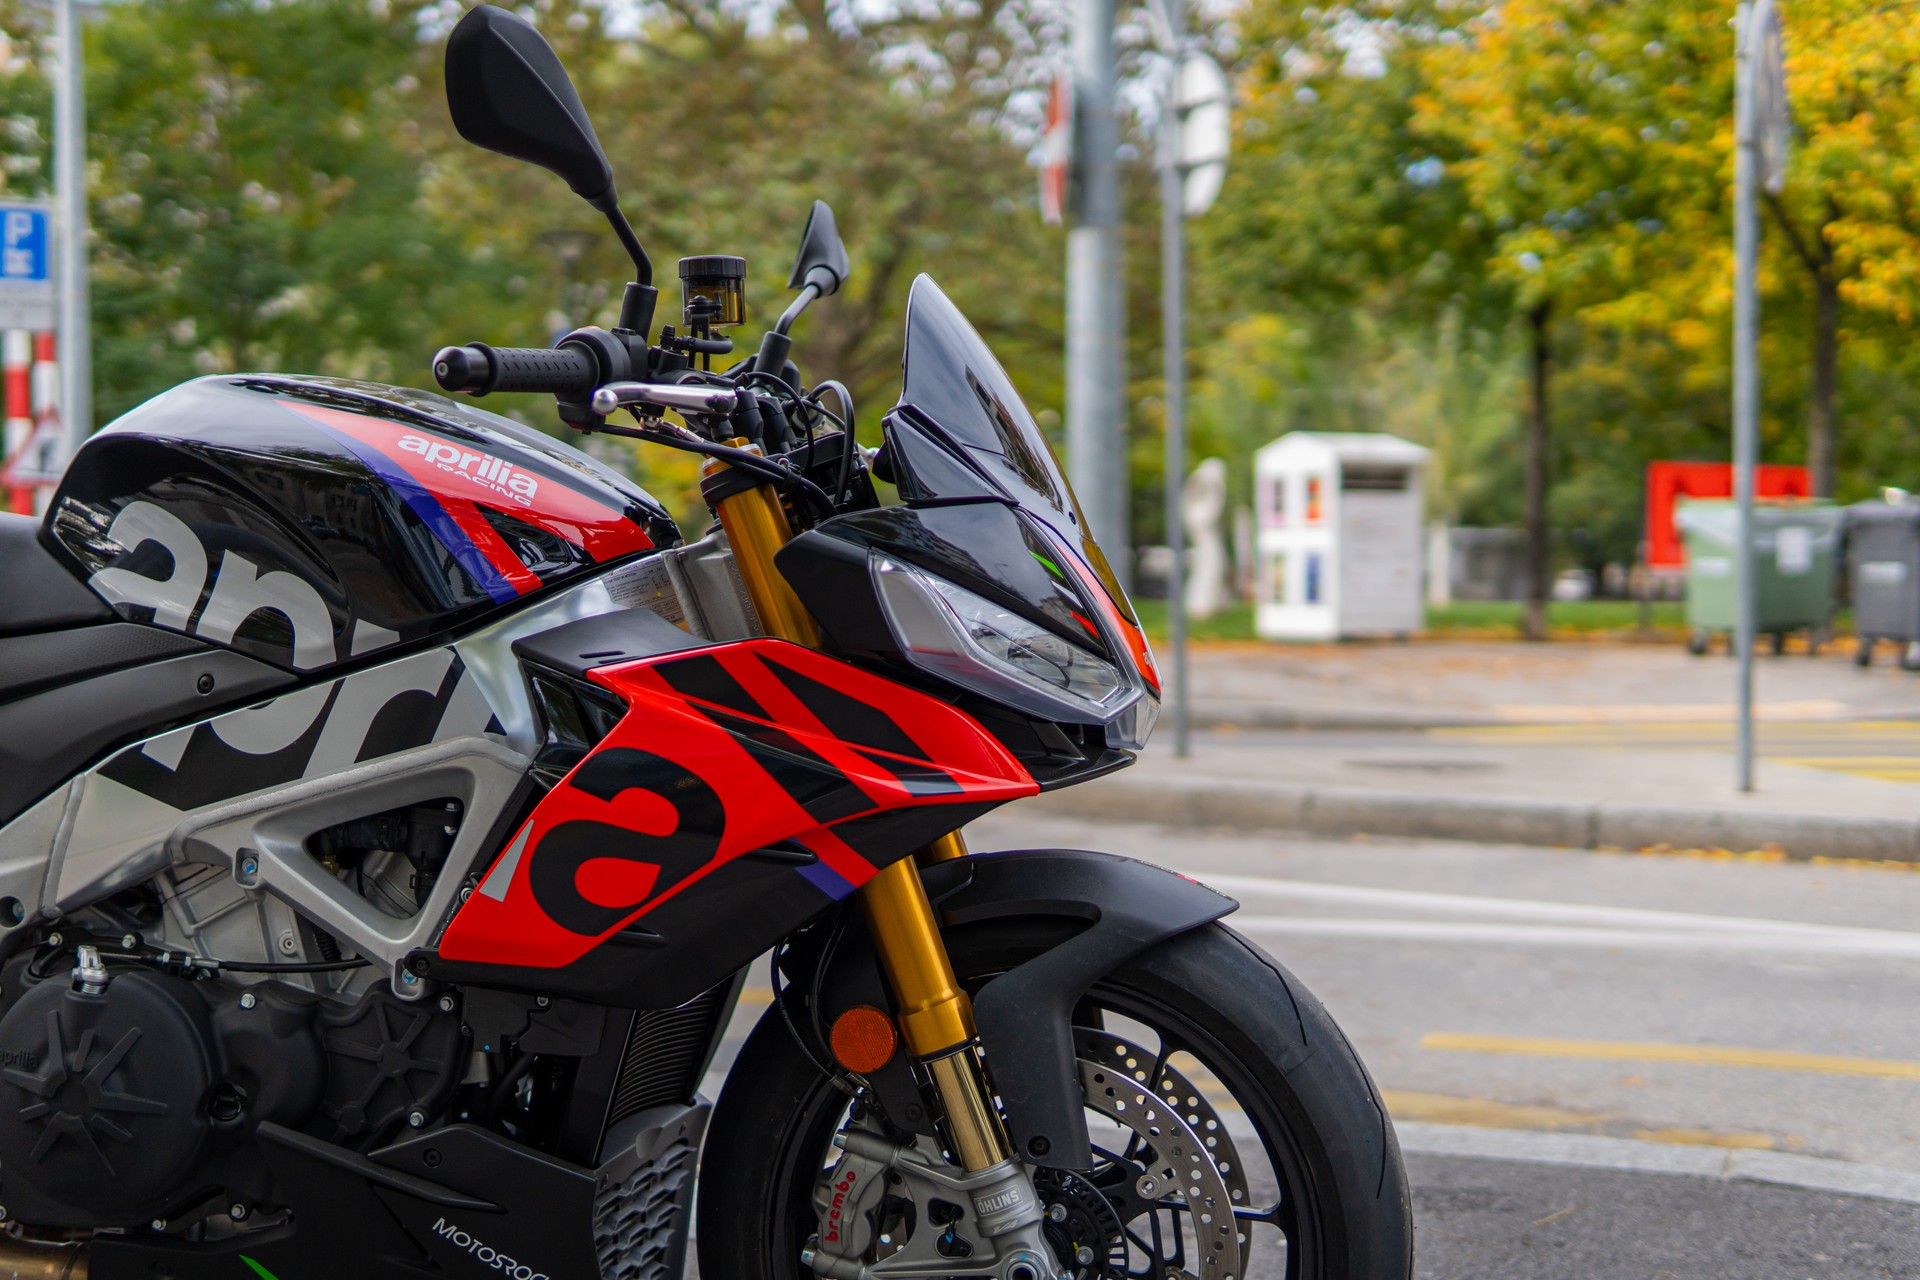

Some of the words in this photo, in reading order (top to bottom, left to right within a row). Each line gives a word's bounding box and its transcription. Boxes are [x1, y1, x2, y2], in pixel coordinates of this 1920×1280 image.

[397, 434, 538, 499] aprilia
[436, 463, 532, 507] RACING
[824, 1171, 857, 1243] brembo
[976, 1190, 1020, 1215] ÖHLINS
